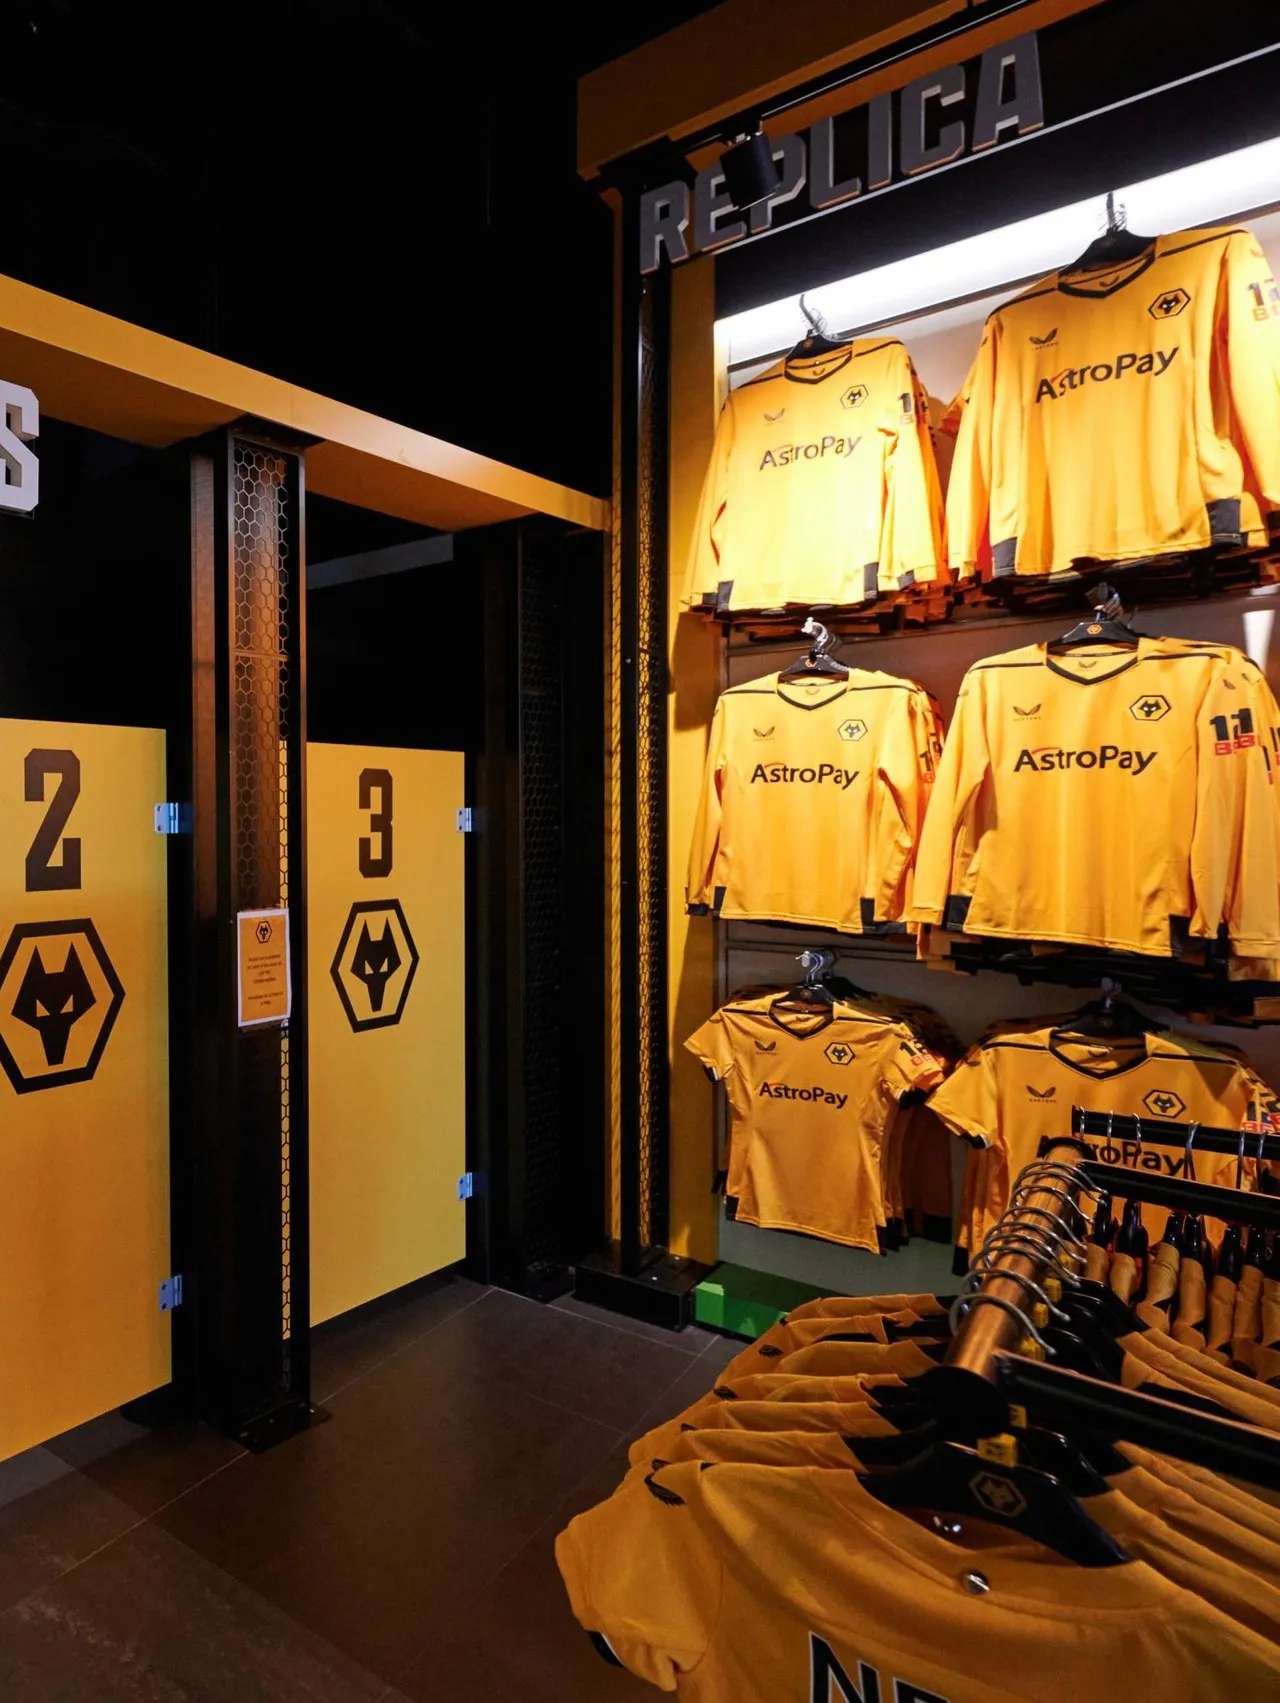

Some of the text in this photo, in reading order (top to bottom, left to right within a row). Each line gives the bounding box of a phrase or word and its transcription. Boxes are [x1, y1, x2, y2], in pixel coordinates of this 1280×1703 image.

[640, 30, 1045, 275] REPLICA
[1035, 346, 1180, 404] AstroPay
[759, 435, 863, 471] AstroPay
[750, 762, 860, 790] AstroPay
[1014, 745, 1158, 776] AstroPay
[24, 748, 82, 892] 2
[359, 768, 393, 878] 3
[759, 1081, 849, 1109] AstroPay
